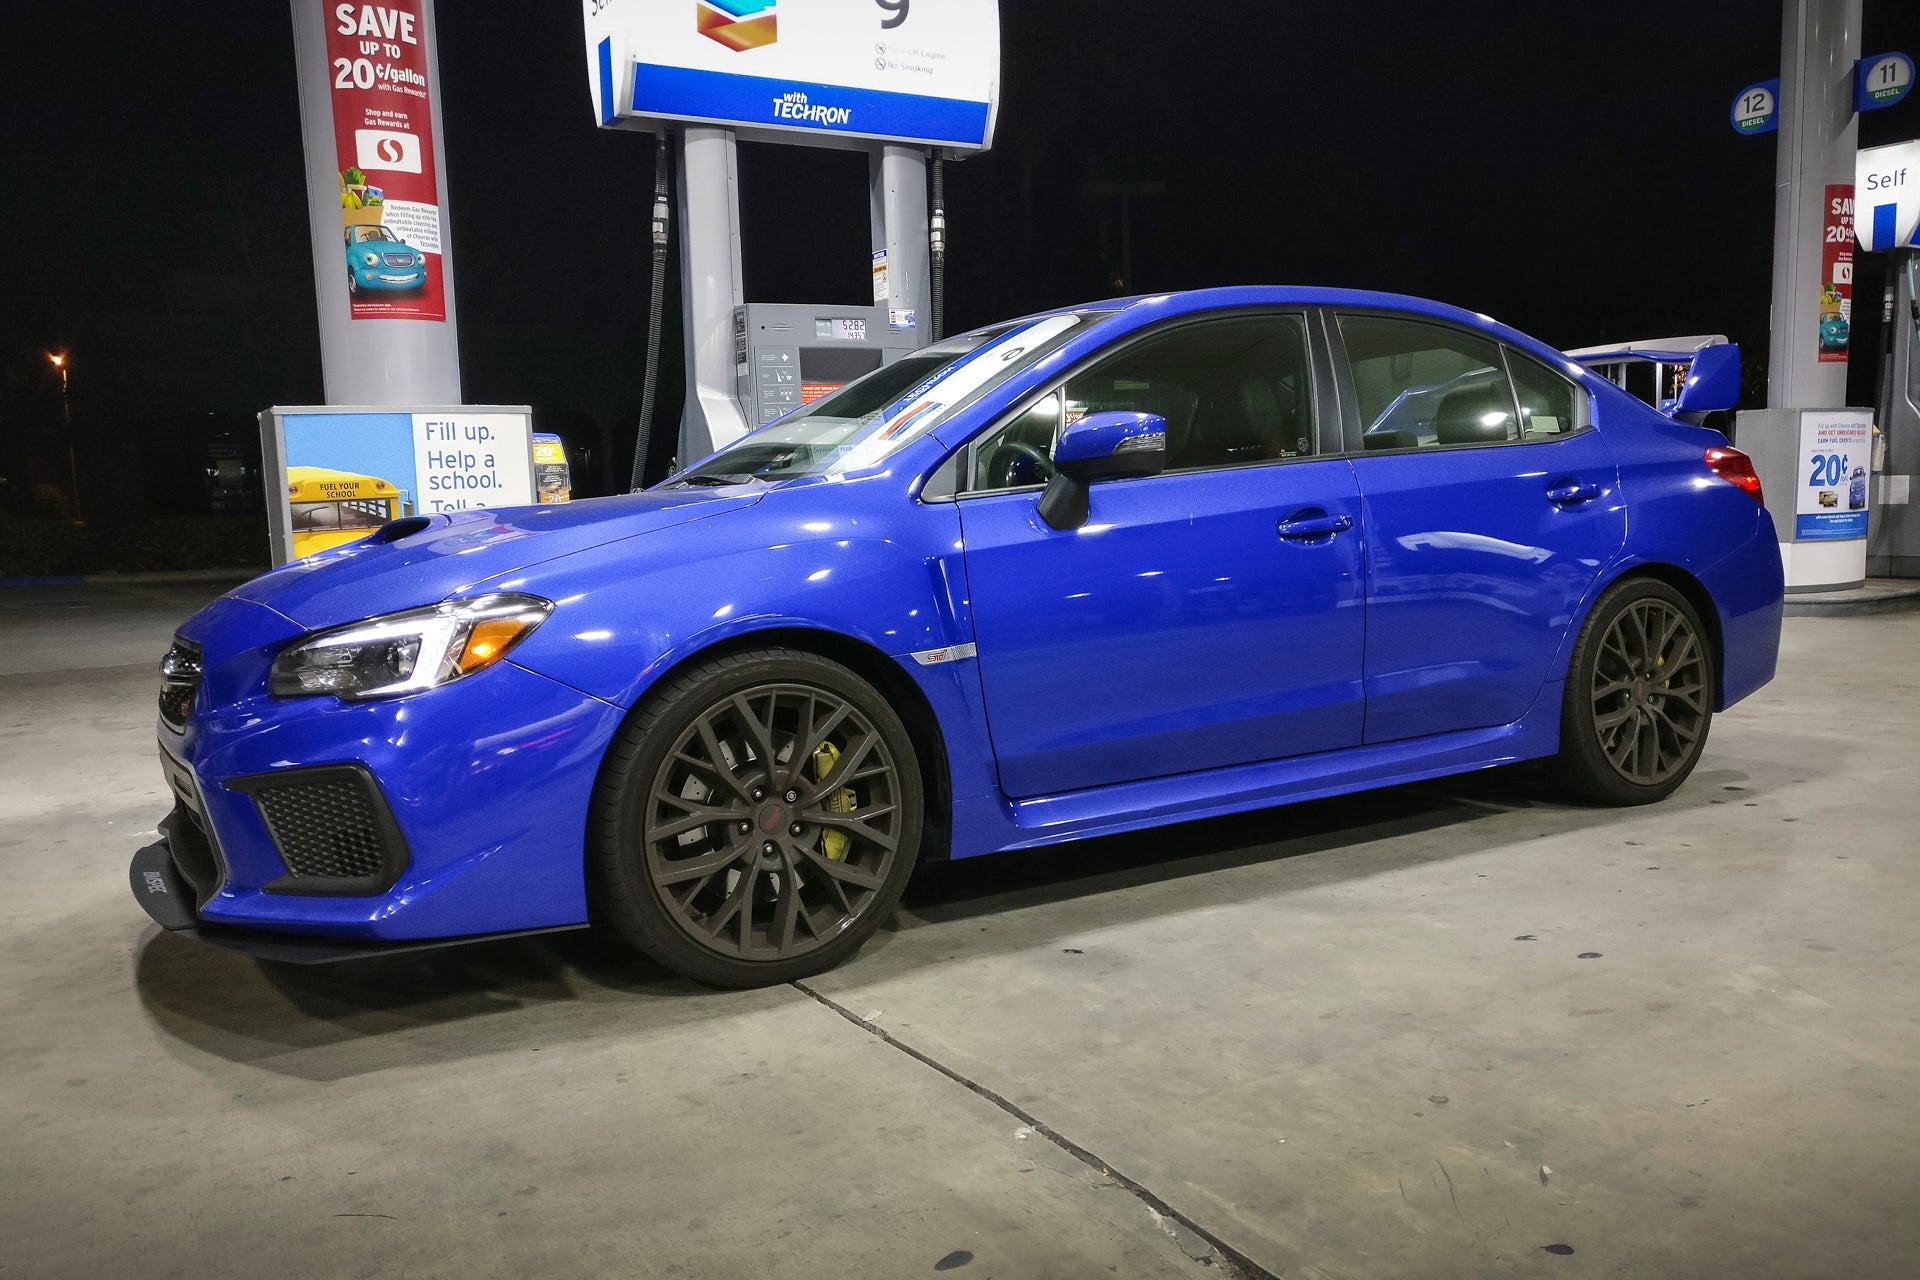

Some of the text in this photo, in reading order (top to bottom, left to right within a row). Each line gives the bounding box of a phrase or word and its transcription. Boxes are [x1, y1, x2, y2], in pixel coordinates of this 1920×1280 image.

[336, 3, 418, 45] SAVE
[360, 40, 401, 59] UP TO
[888, 61, 933, 76] No Smoking
[1880, 62, 1896, 84] 11
[378, 83, 392, 92] with
[392, 84, 404, 94] Gas
[783, 91, 808, 104] with
[1874, 88, 1900, 99] DIESEL
[773, 98, 850, 126] TECHRON
[1743, 92, 1764, 114] 12
[365, 108, 381, 118] Shop
[382, 110, 394, 118] and
[364, 118, 376, 126] Gas
[378, 119, 403, 128] Rewards
[1742, 117, 1764, 128] DIESEL
[1866, 168, 1907, 190] Self
[1832, 198, 1855, 215] SAV
[426, 422, 495, 444] Fill up.
[428, 450, 495, 472] Help a
[1809, 454, 1848, 486] 20¢
[320, 482, 338, 491] FUEL
[429, 470, 502, 490] school.
[326, 490, 357, 498] SCHOOL
